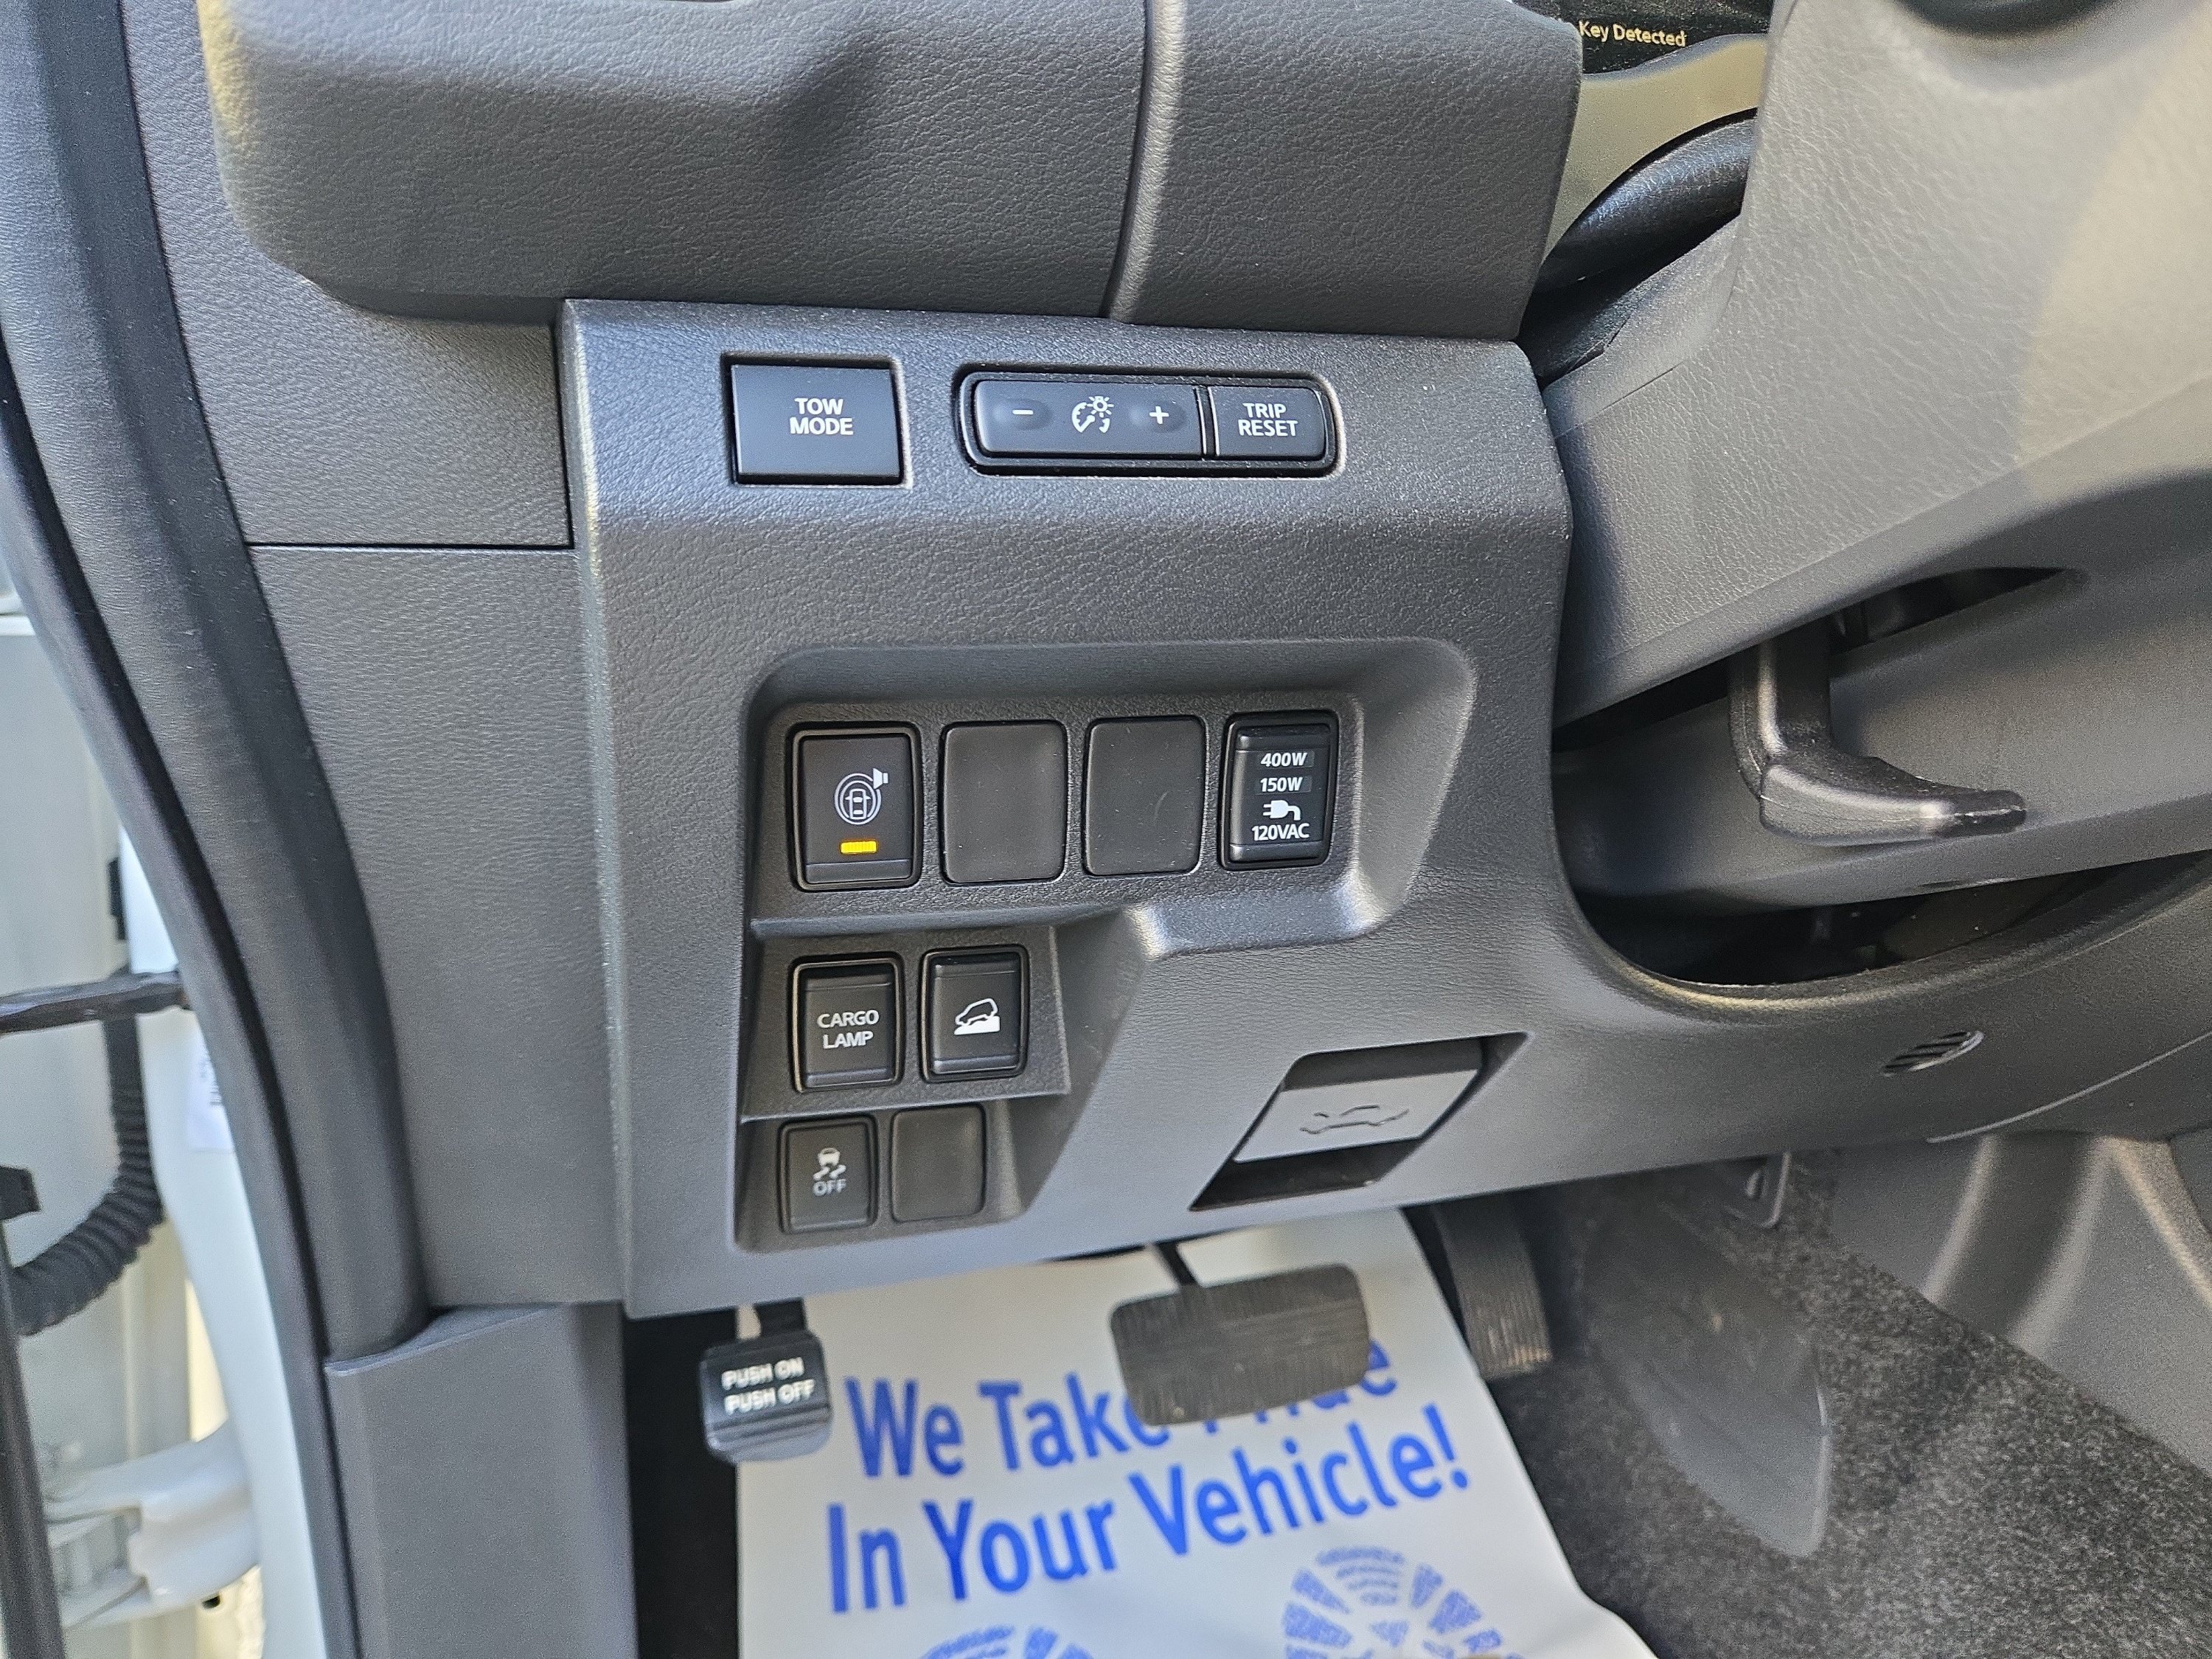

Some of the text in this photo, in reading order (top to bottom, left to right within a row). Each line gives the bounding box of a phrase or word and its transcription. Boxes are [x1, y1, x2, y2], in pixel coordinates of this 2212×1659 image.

[1579, 21, 1687, 47] Key Detected
[794, 397, 844, 415] TOW
[1242, 403, 1287, 419] TRIP
[790, 417, 854, 435] MODE
[1238, 419, 1298, 437] RESET
[1260, 752, 1308, 768] 400W
[1260, 776, 1303, 793] 150W
[1251, 822, 1310, 841] 120VAC
[816, 1009, 880, 1029] CARGO
[822, 1031, 874, 1049] LAMP
[813, 1179, 846, 1196] OFF
[721, 1357, 805, 1391] PUSH ON
[723, 1379, 815, 1415] PUSH OFF
[844, 1376, 964, 1478] We
[827, 1403, 1470, 1614] In Your Vehicle!
